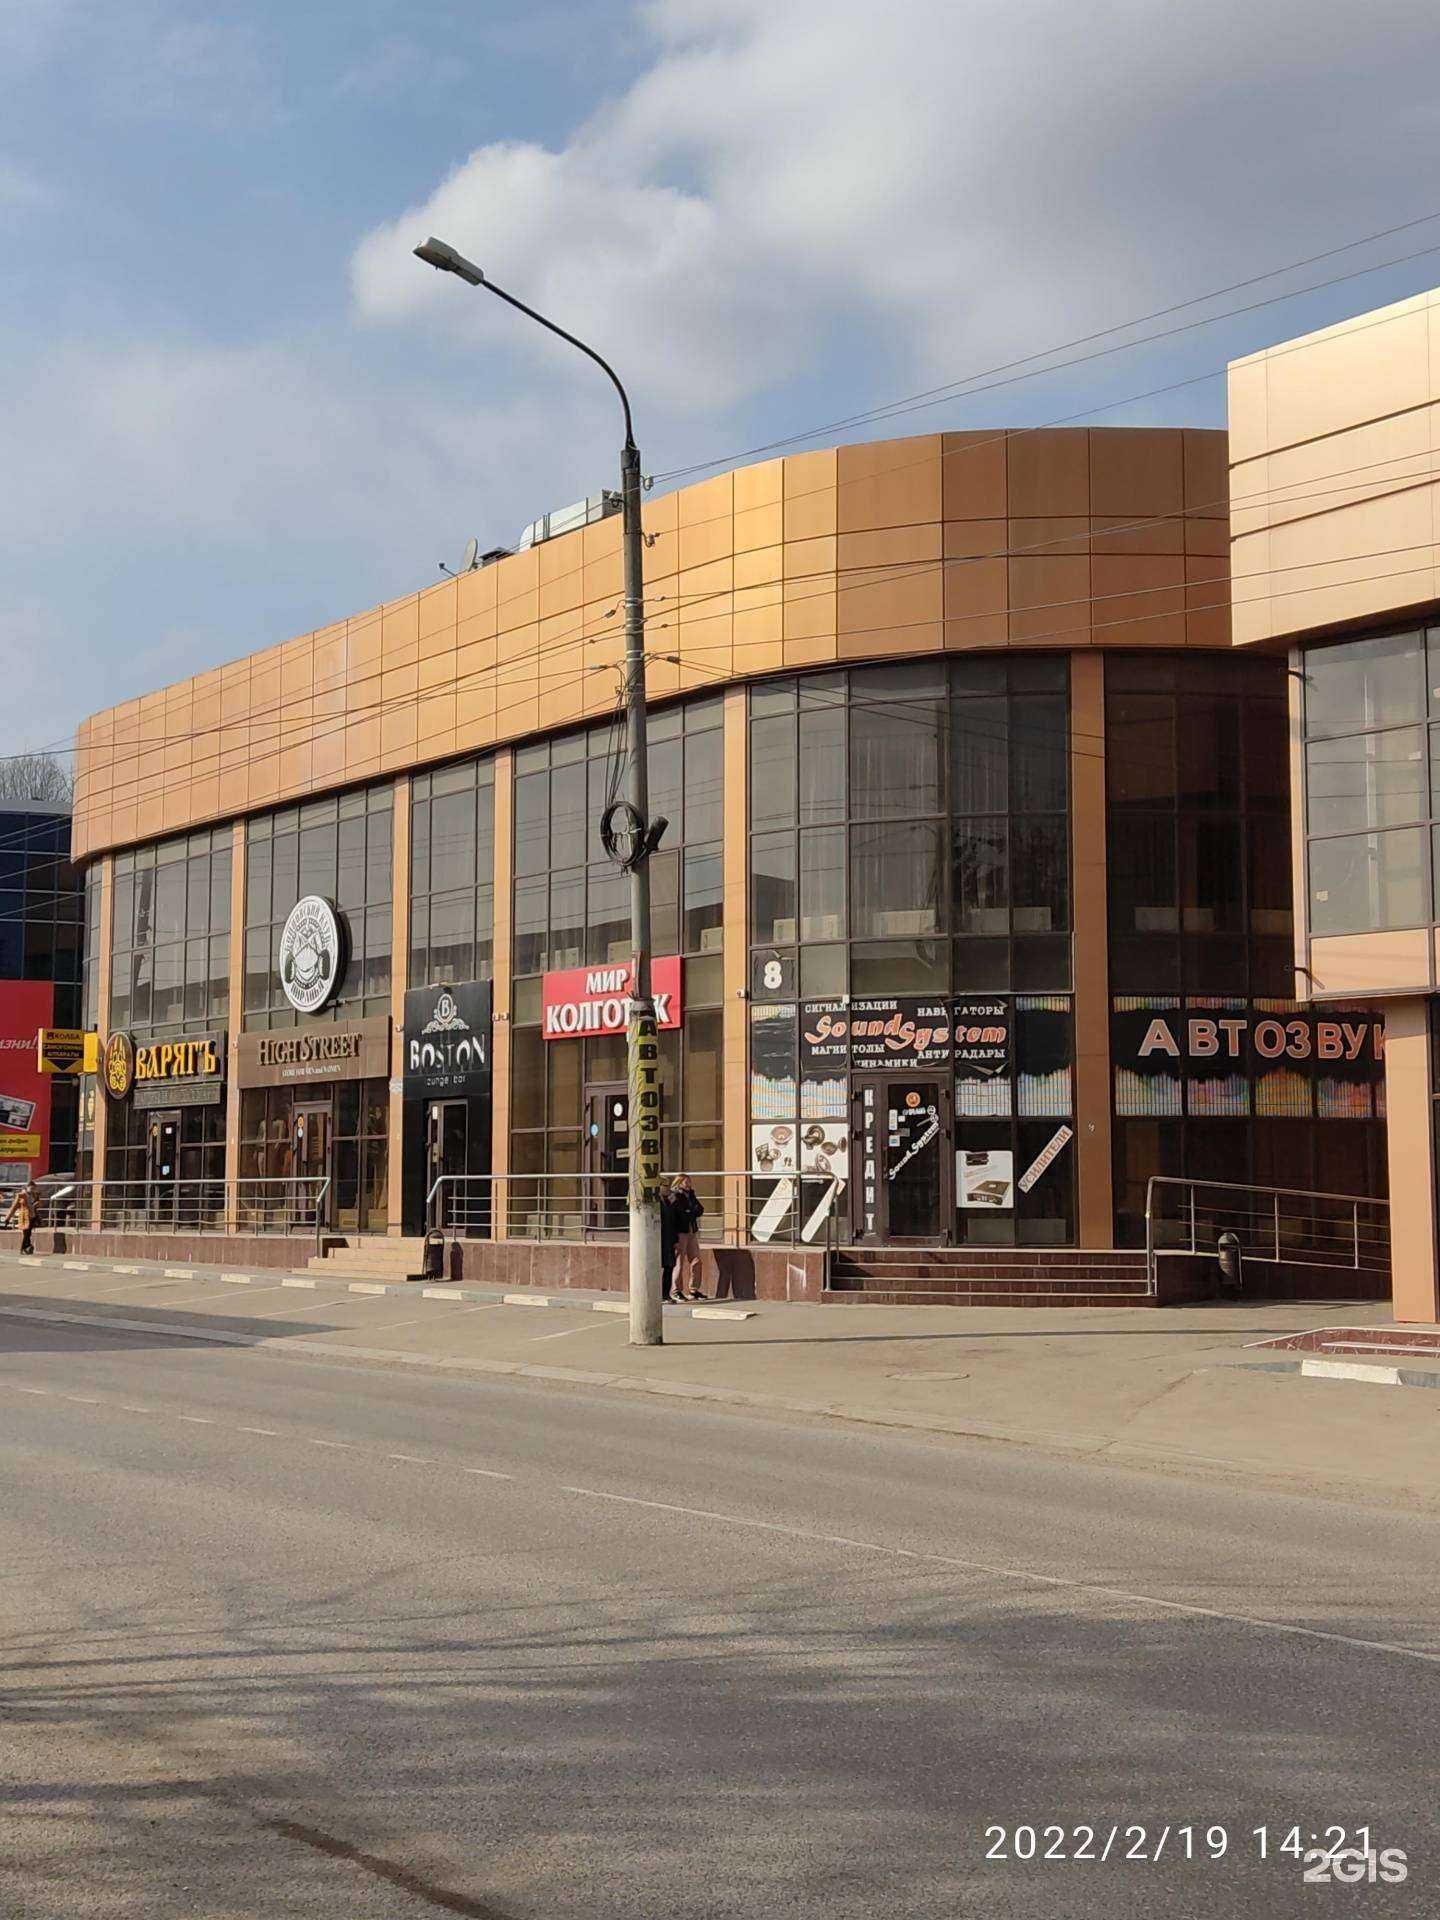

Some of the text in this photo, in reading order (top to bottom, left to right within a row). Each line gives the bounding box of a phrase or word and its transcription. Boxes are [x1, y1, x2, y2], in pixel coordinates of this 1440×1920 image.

[586, 968, 628, 994] МИР
[764, 961, 782, 989] 8
[441, 999, 450, 1017] B
[546, 993, 670, 1033] КОЛГОТК
[135, 1040, 217, 1079] ВАРЯГЪ
[410, 1034, 485, 1070] BOSTON
[811, 1044, 885, 1056] МАГНИТОЛЫ
[864, 1089, 875, 1230] КРЕДИТ
[1020, 1128, 1070, 1190] УСИЛИТЕЛИ
